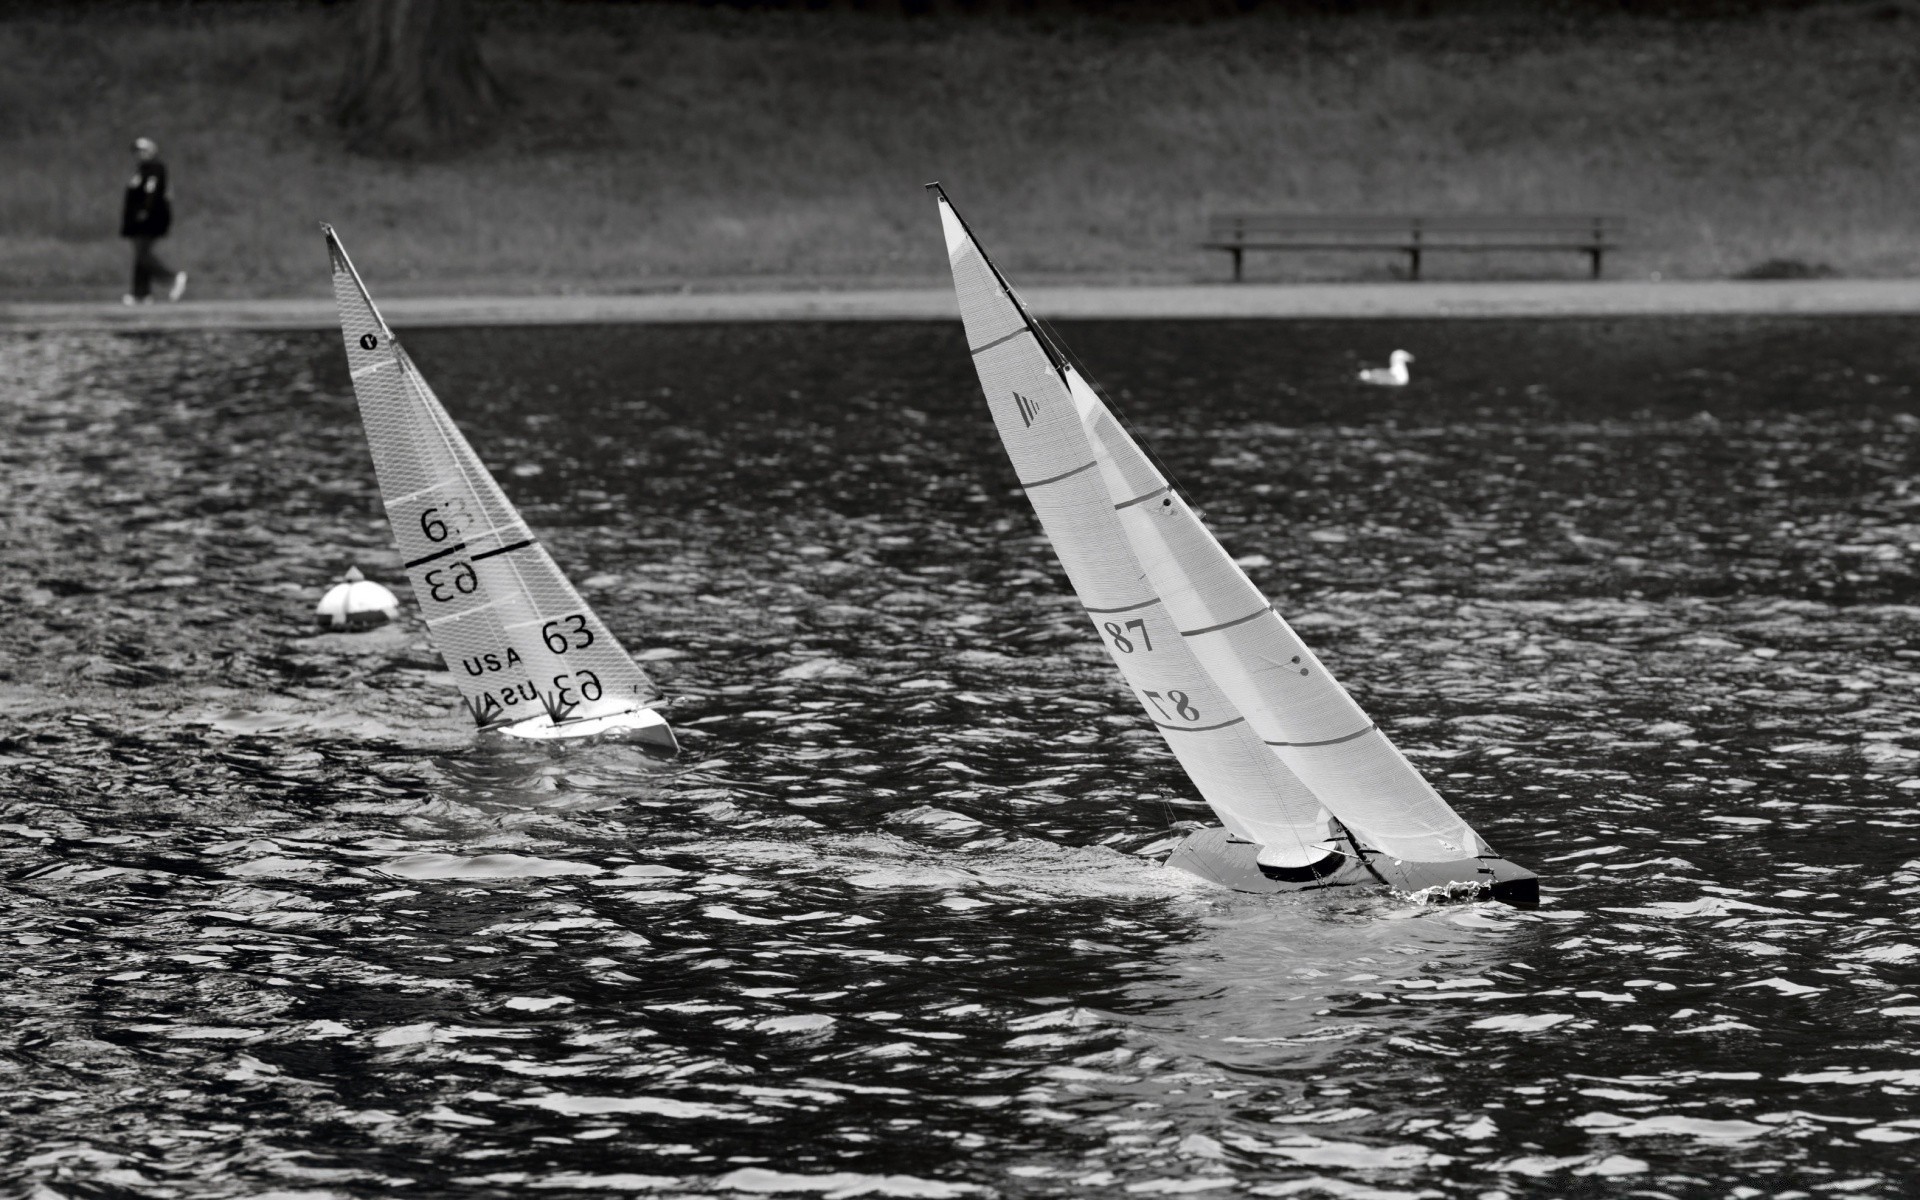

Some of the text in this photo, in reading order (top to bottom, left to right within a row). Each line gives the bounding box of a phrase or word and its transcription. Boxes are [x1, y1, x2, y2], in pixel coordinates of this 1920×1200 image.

[542, 614, 594, 655] 63
[1104, 618, 1153, 653] 87
[462, 647, 522, 676] USA
